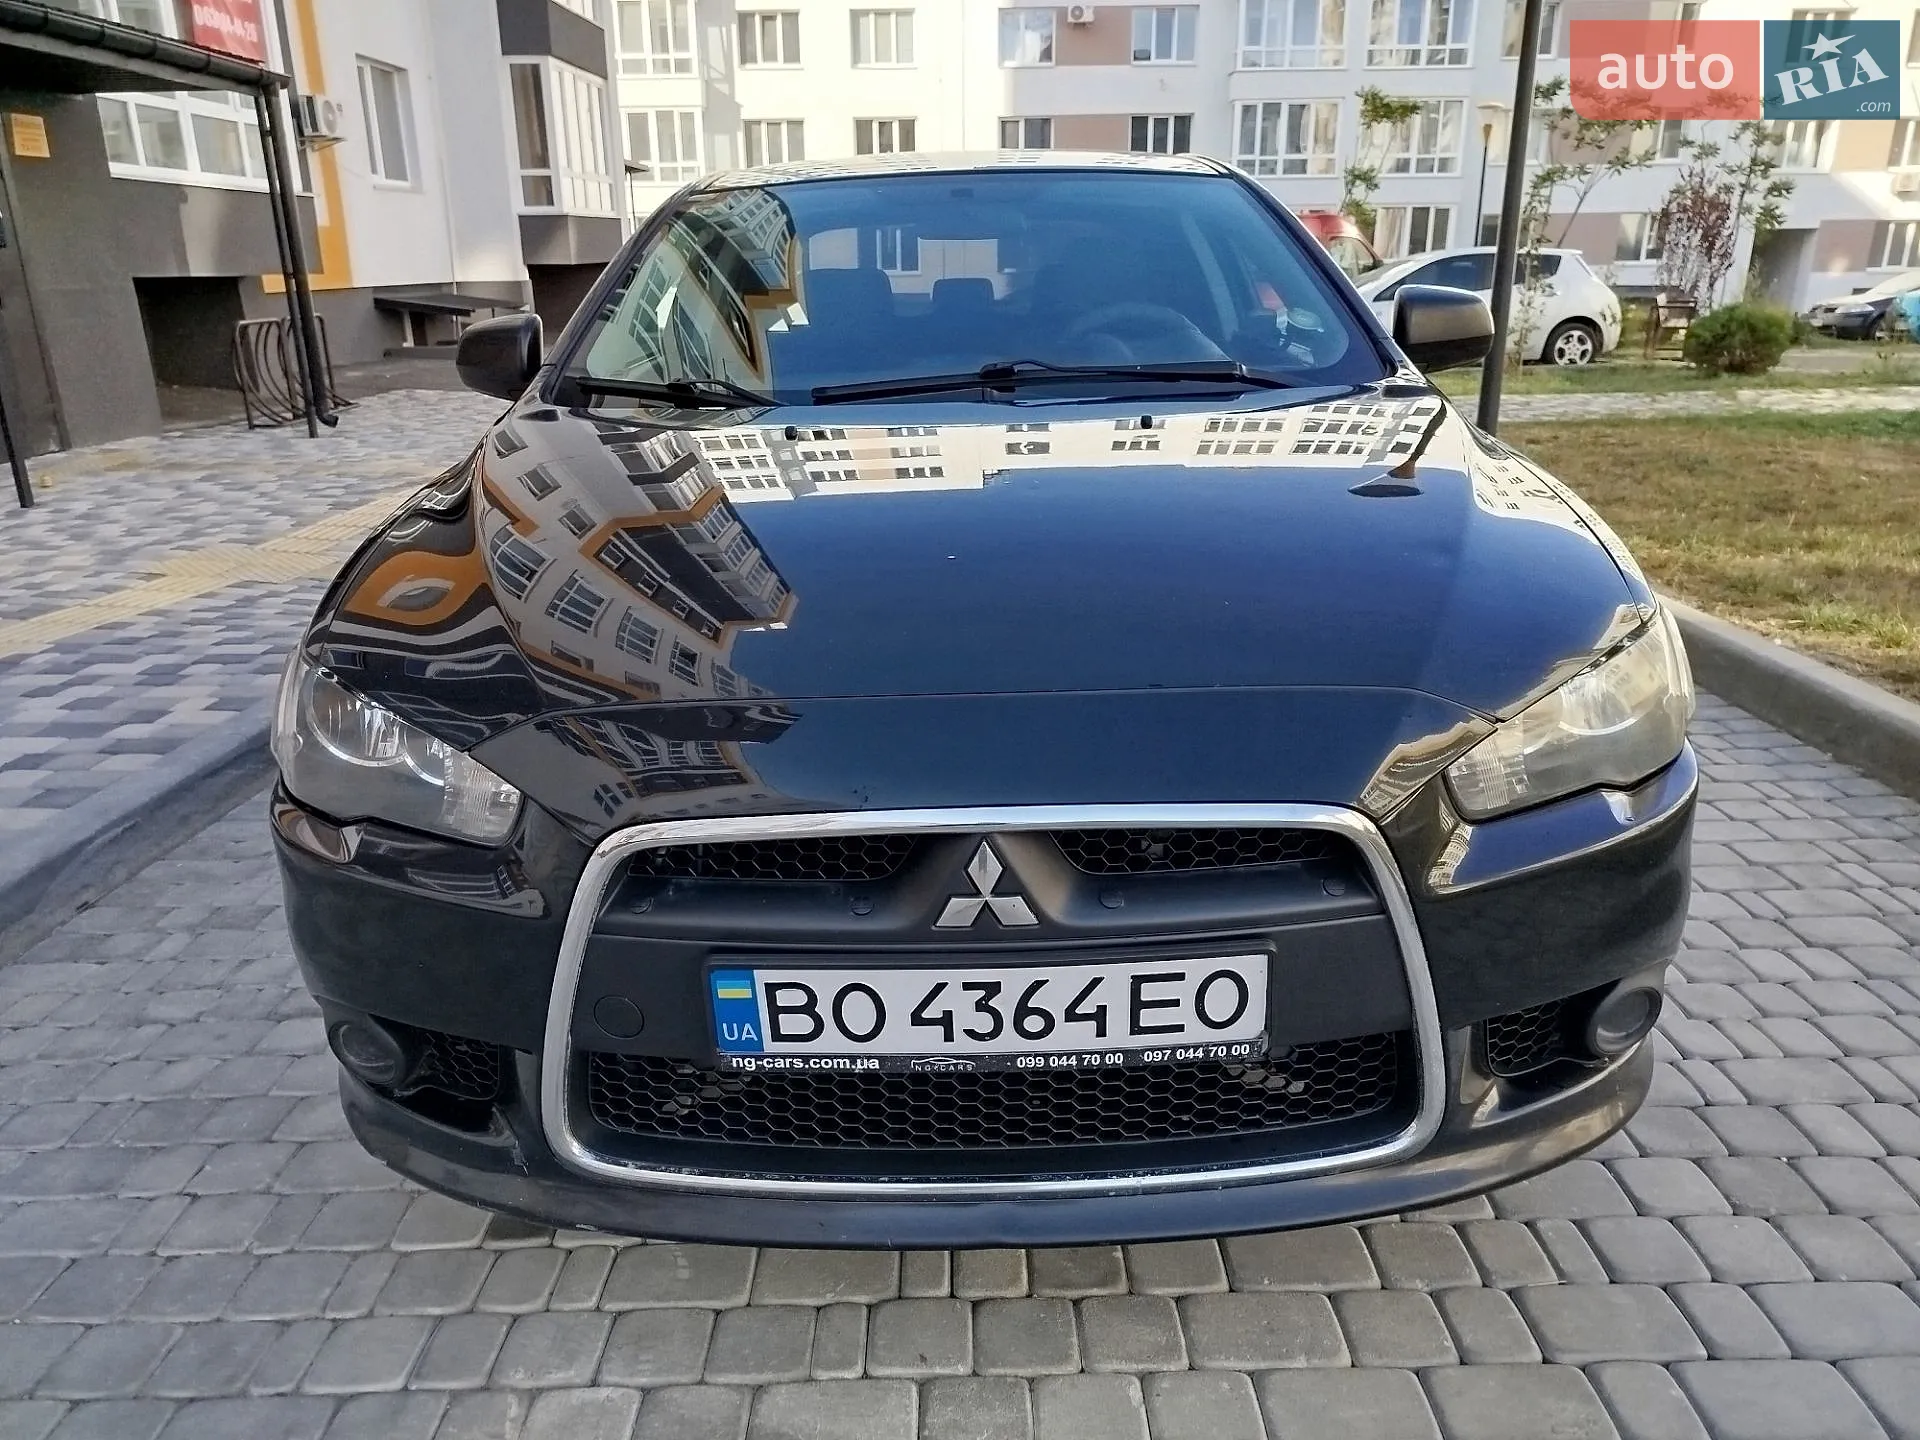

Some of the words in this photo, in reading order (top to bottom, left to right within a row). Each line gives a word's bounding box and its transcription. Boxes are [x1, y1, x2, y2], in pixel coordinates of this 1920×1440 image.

[763, 981, 887, 1044] BO
[909, 976, 1108, 1043] 4364
[1128, 969, 1250, 1036] EO
[722, 1022, 759, 1042] UA
[1016, 1056, 1045, 1068] 099
[1049, 1054, 1077, 1067] 044
[1082, 1053, 1101, 1066] 70
[1105, 1052, 1124, 1065] 00
[1143, 1049, 1172, 1062] 097
[1176, 1047, 1204, 1060] 044
[1208, 1045, 1227, 1057] 70
[1231, 1043, 1250, 1056] 00
[731, 1056, 880, 1071] ng-cars.com.ua
